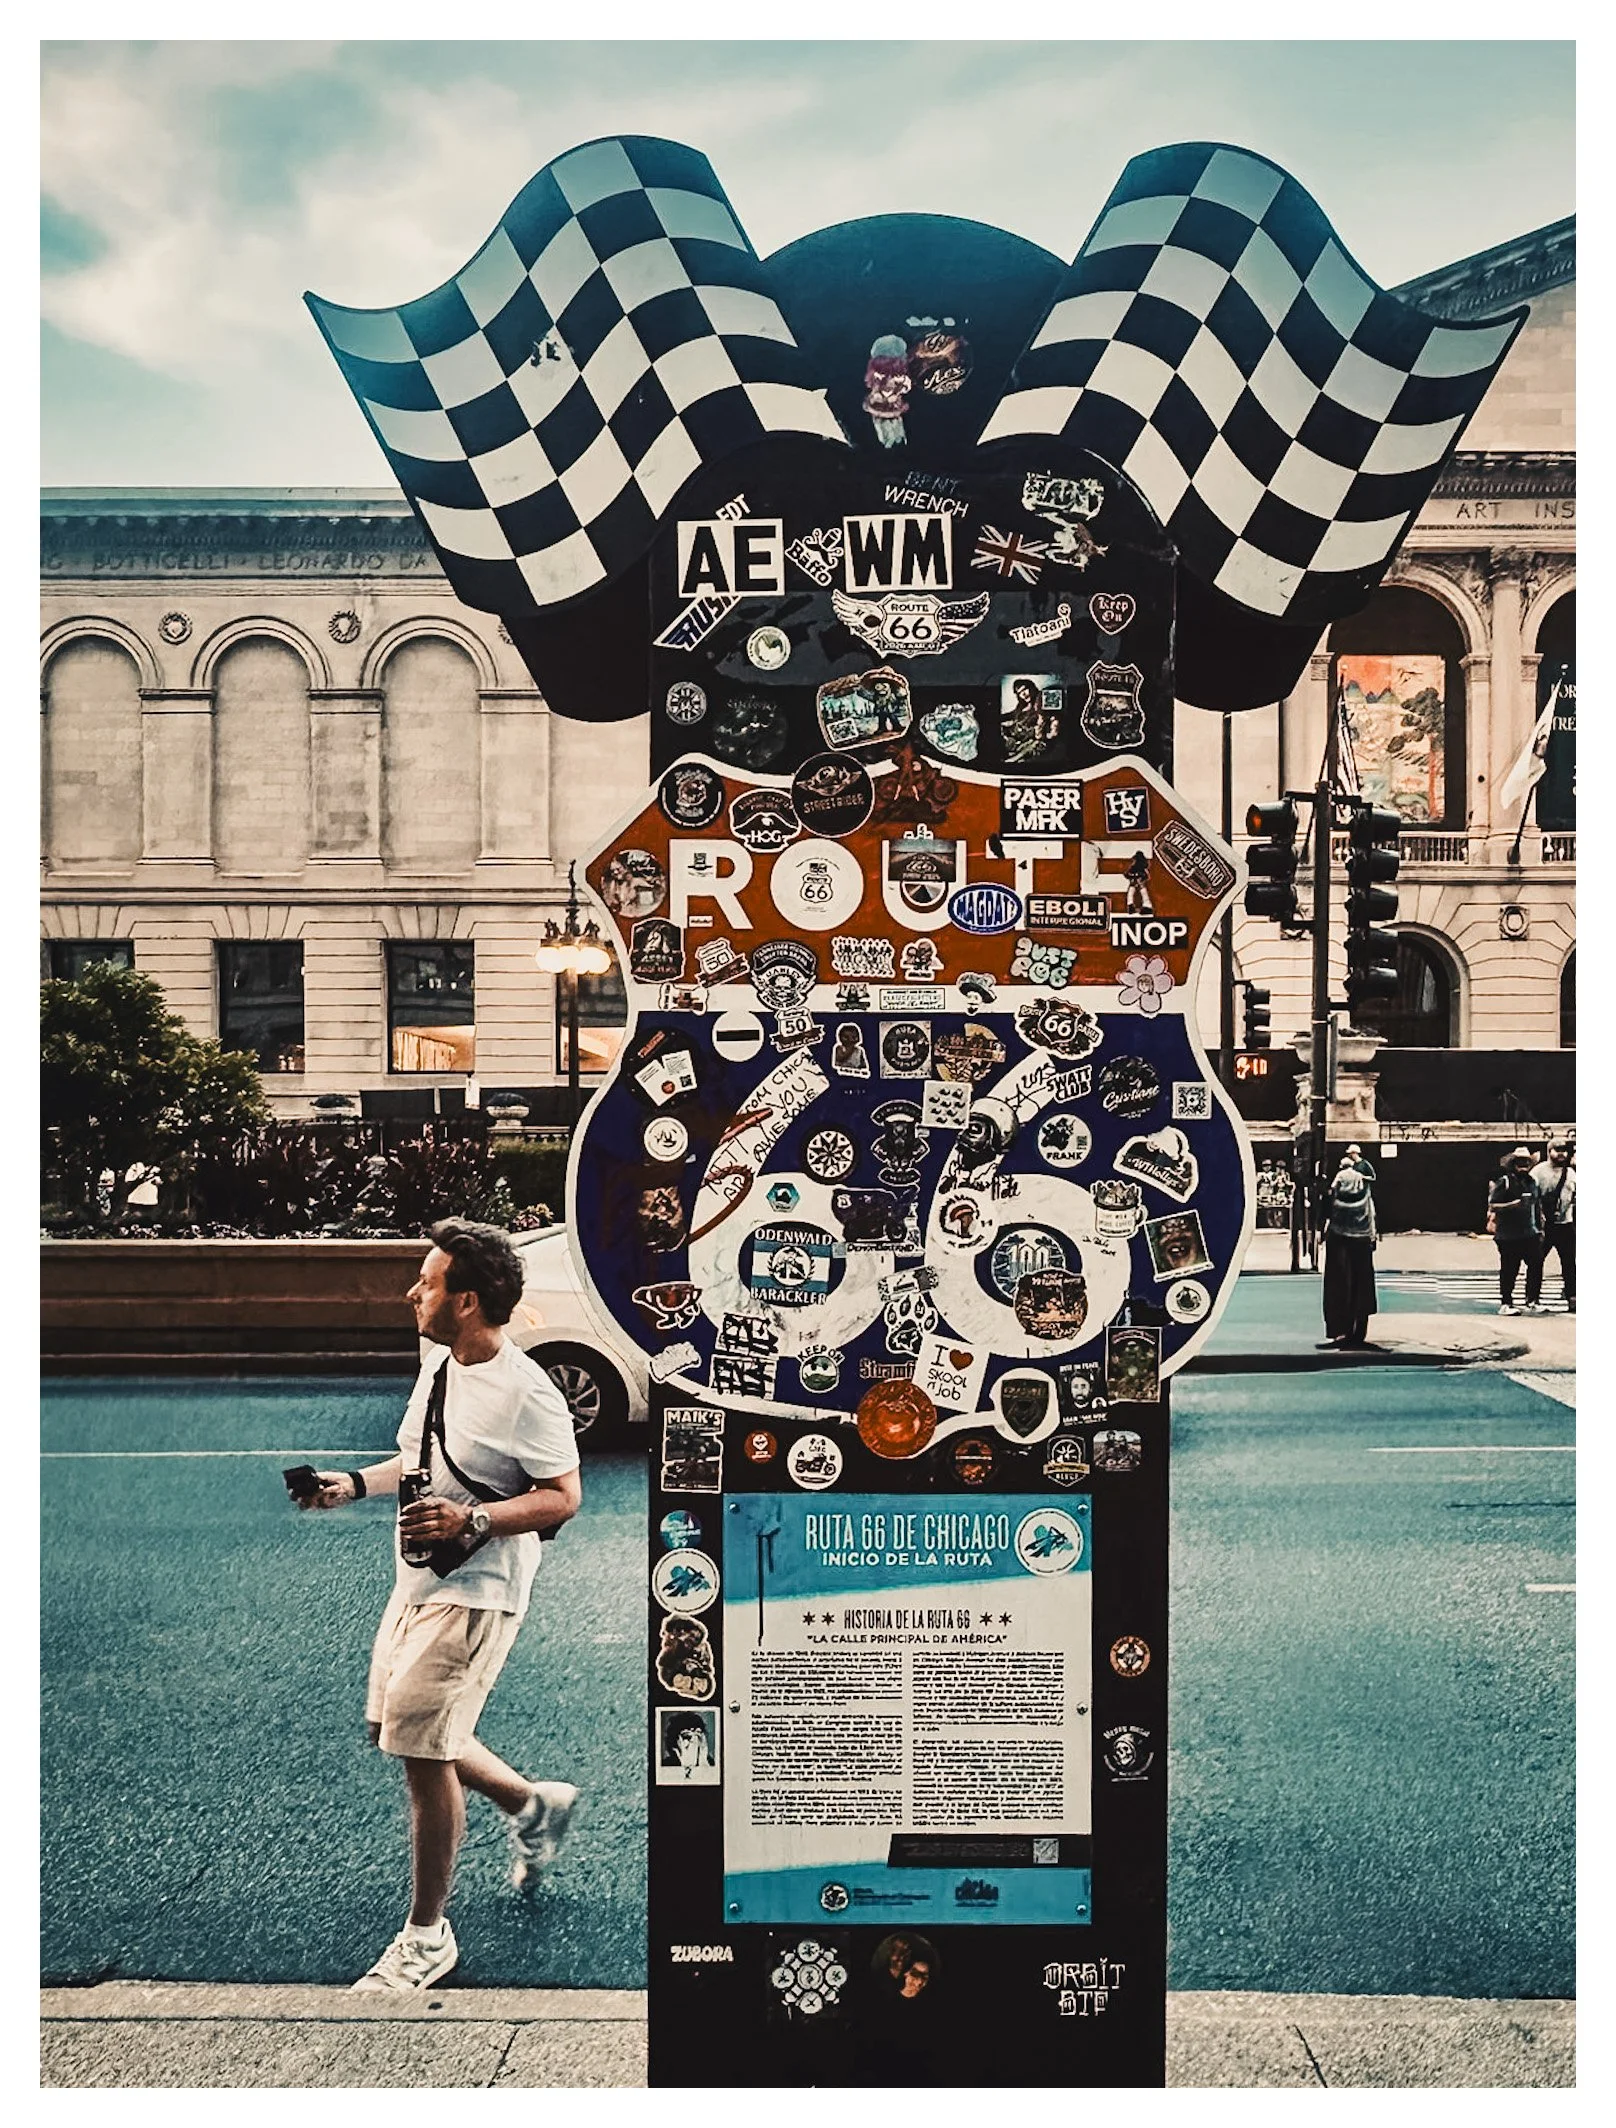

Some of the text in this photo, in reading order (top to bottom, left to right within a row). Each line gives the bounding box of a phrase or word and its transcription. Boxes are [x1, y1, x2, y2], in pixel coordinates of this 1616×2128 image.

[884, 484, 969, 518] WRENCH
[1456, 501, 1575, 519] ART INS
[681, 525, 779, 593] AE
[847, 518, 949, 586] WM
[890, 603, 930, 613] ROUTE
[889, 616, 932, 640] 66
[1012, 617, 1071, 641] Tlatoani
[1003, 788, 1082, 811] PASER
[1014, 809, 1069, 832] MFK
[750, 830, 783, 843] HOG
[1164, 827, 1226, 888] SWEDESBORO
[668, 838, 1154, 931] ROUTE
[804, 884, 828, 899] 66
[1029, 900, 1105, 916] EBOLI
[1029, 916, 1104, 927] INTERREGIONAL
[1111, 921, 1188, 947] INOP
[784, 1018, 807, 1034] 50
[1044, 1014, 1073, 1037] 66
[1046, 1151, 1083, 1160] FRANK
[754, 1227, 833, 1246] ODENWALD
[750, 1286, 828, 1306] BARACKLER
[798, 1344, 827, 1361] KEEP
[667, 1410, 723, 1426] MAIK'S
[806, 1514, 1009, 1550] RUTA 66 DE CHICAGO
[822, 1552, 993, 1566] INICIO DE LA RUTA
[844, 1609, 971, 1629] HISTORIA DE LA RUTA 66
[830, 1634, 868, 1644] CALLE
[871, 1634, 930, 1644] PRINCIPAL
[932, 1634, 948, 1644] DE
